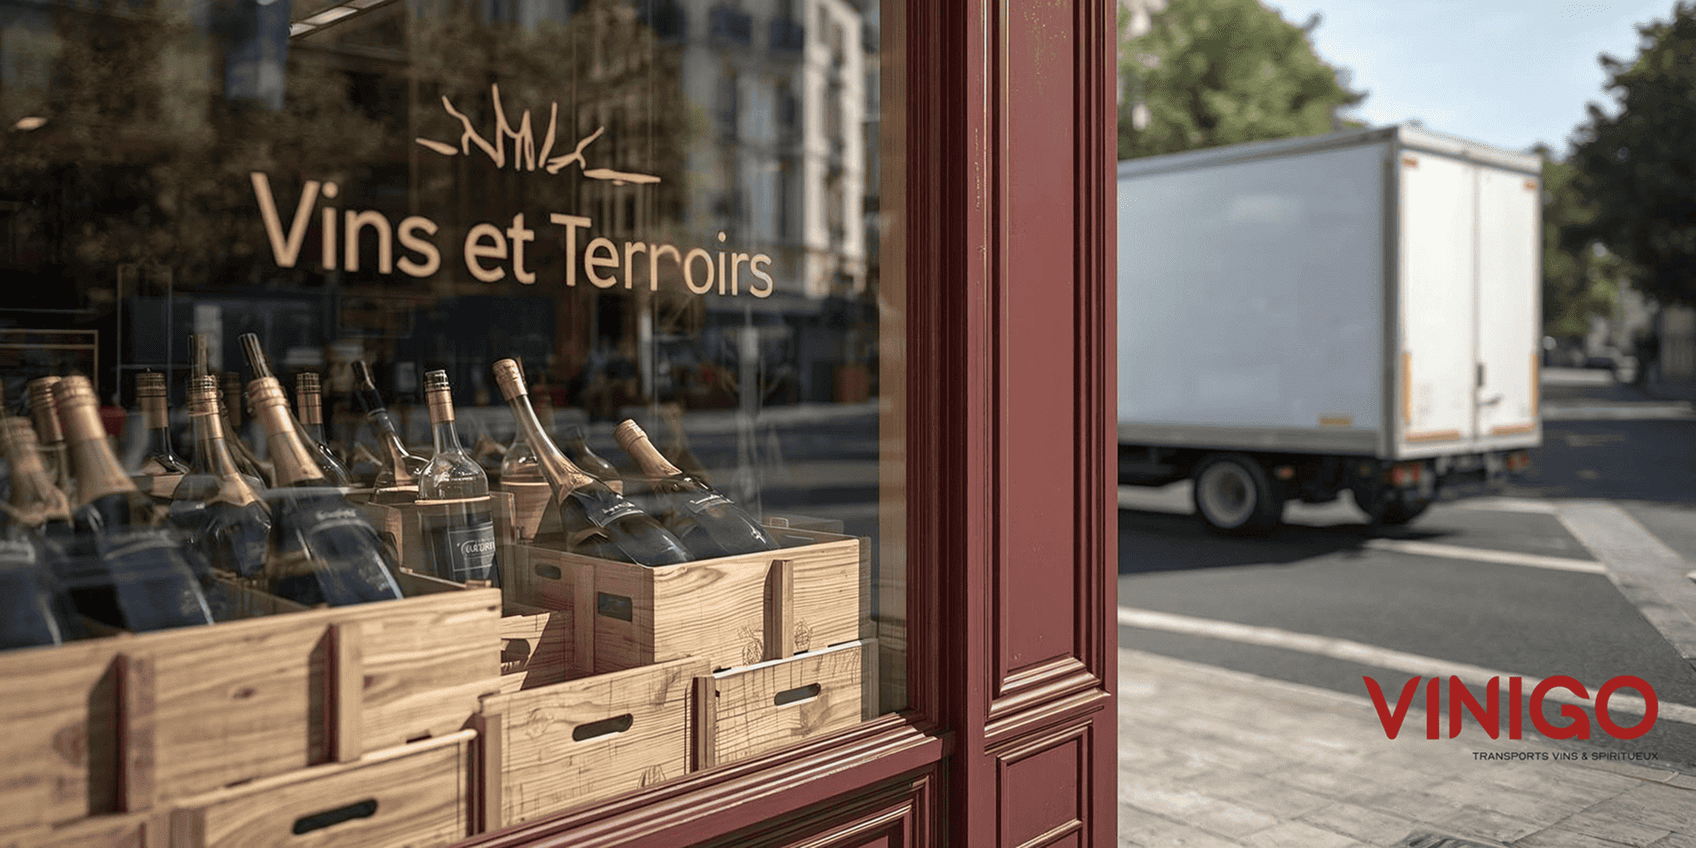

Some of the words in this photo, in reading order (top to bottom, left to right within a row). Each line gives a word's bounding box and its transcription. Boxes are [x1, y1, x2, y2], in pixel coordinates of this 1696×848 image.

[250, 171, 442, 278] Vins
[463, 212, 536, 285] et
[549, 213, 775, 299] Terroirs
